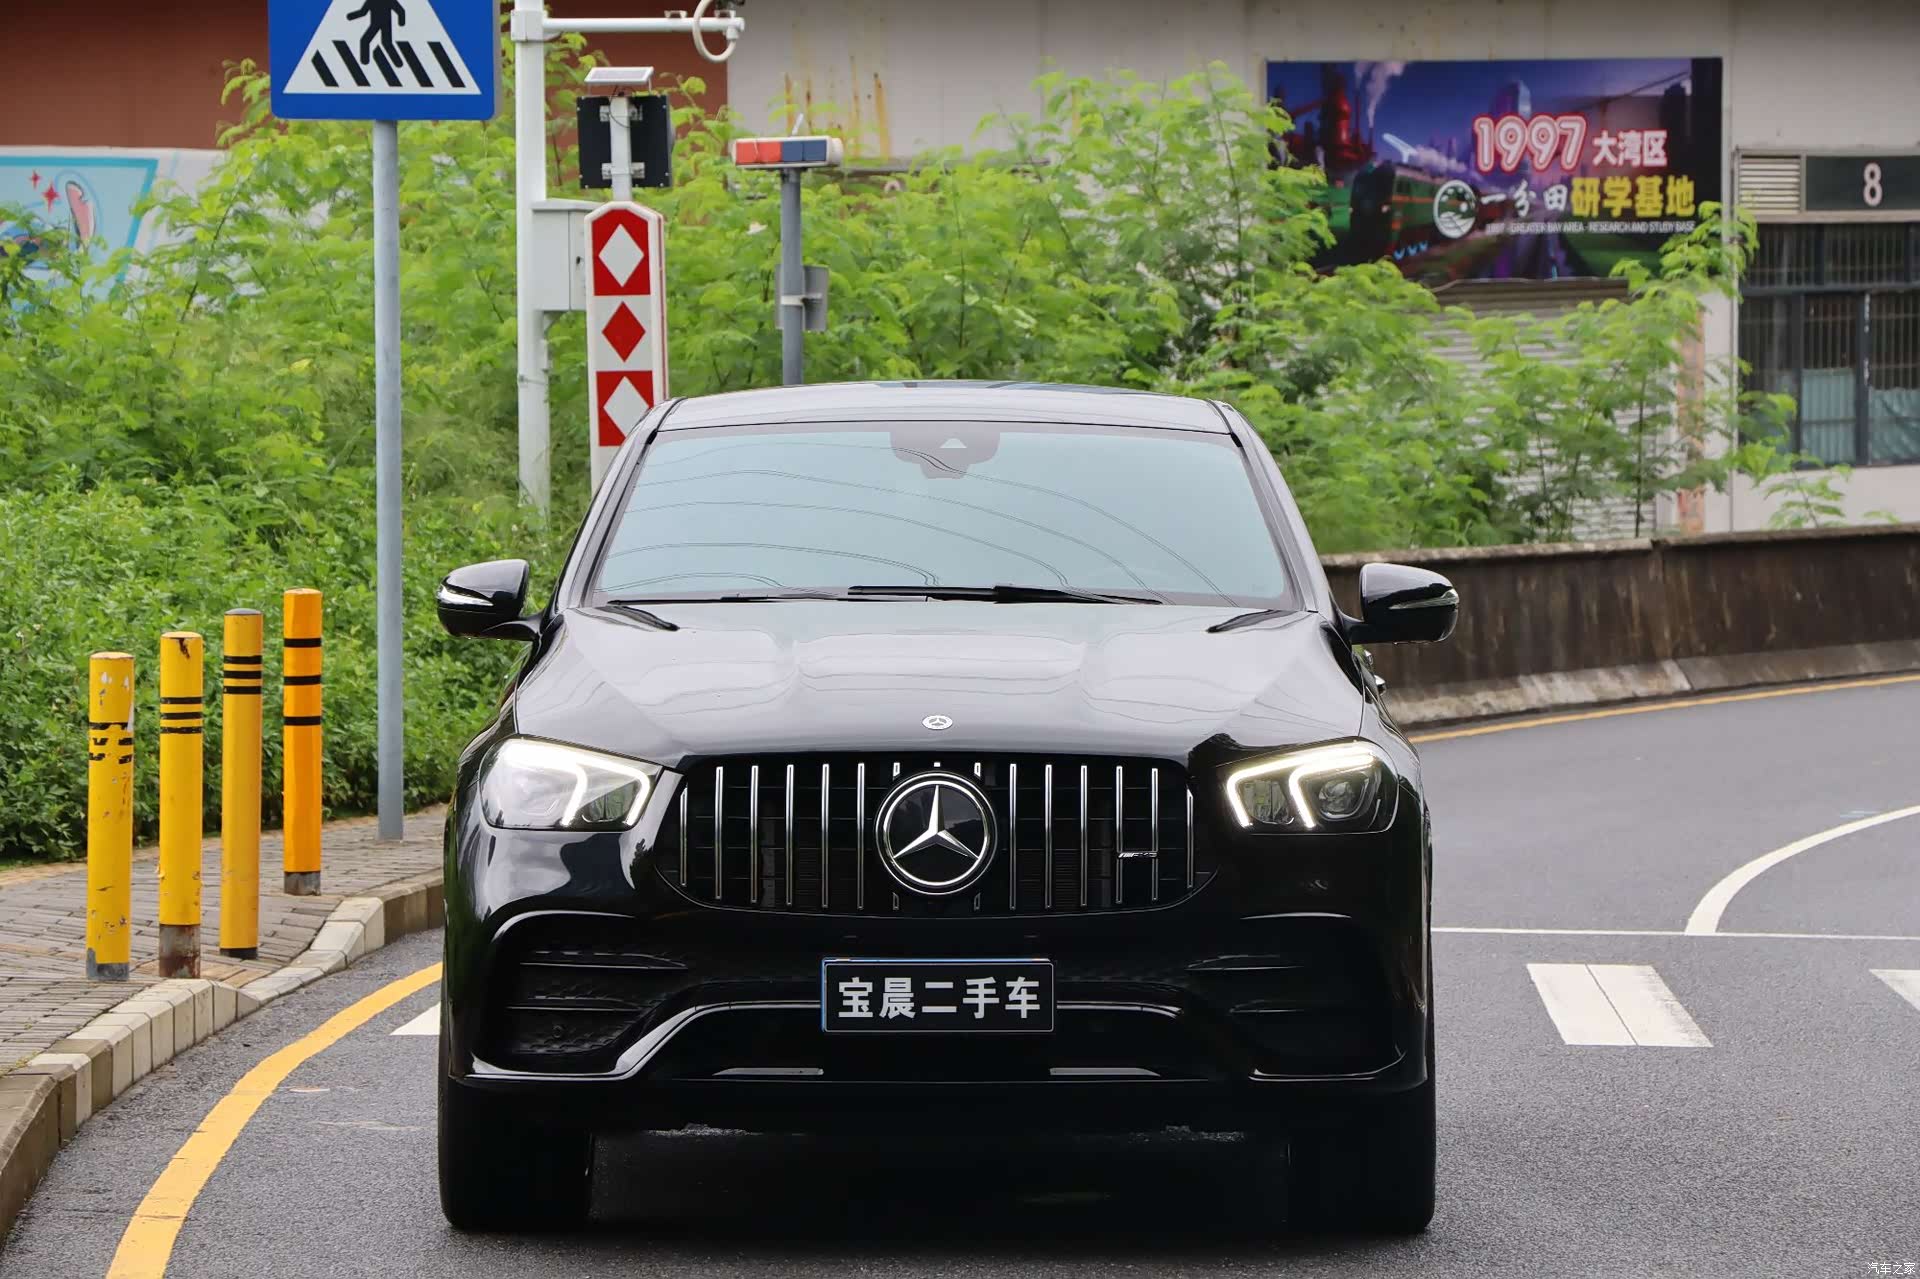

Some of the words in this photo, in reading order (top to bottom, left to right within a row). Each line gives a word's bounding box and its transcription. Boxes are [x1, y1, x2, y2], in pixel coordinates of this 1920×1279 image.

[1473, 113, 1587, 173] 1997
[1593, 129, 1667, 167] 大湾区
[1863, 162, 1883, 207] 8
[1547, 221, 1561, 234] BAY
[1563, 221, 1584, 233] AREA
[1588, 221, 1630, 234] RESEARCH
[1631, 221, 1648, 233] AND
[1649, 221, 1673, 233] STUDY
[1675, 220, 1695, 233] BASE
[838, 976, 1041, 1019] 宝晨二手车
